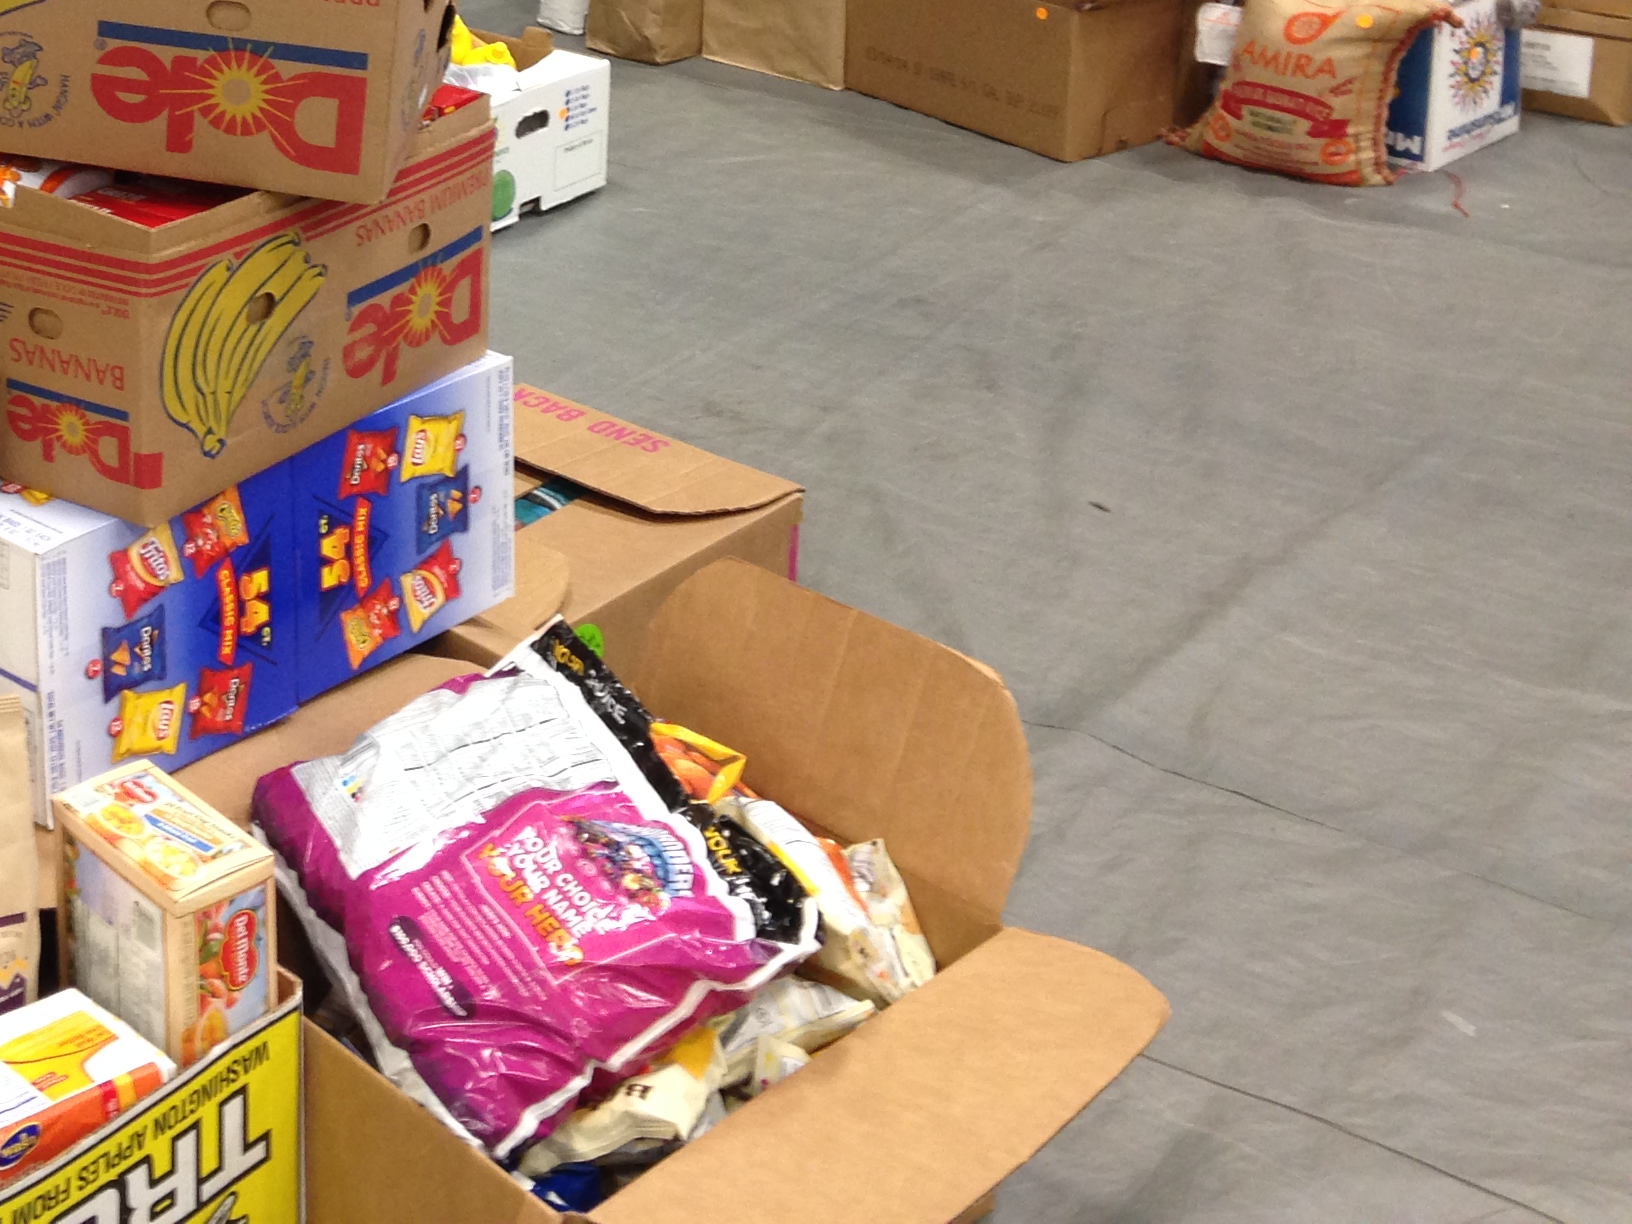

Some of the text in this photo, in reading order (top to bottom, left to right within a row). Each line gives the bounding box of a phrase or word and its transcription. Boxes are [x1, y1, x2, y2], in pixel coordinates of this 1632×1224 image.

[1242, 39, 1337, 79] AMIRA
[89, 44, 369, 176] Dole
[342, 246, 485, 387] Dole
[8, 336, 125, 392] BANANAS
[5, 393, 132, 485] Dole
[587, 419, 672, 453] SEND
[138, 536, 172, 581] Fritos
[319, 525, 352, 593] 54
[353, 505, 370, 589] CLASSIC MIX
[219, 569, 237, 656] CLASSIC MIX
[238, 566, 271, 636] 54
[223, 677, 240, 721] Doritos
[514, 826, 563, 876] YOUR
[476, 843, 535, 905] YOUR
[523, 903, 586, 966] HERO
[505, 841, 594, 939] YOUR NAME
[234, 915, 250, 982] Del Monte
[153, 1040, 271, 1142] WASHINGTON
[77, 1134, 149, 1192] APPLES
[11, 1181, 72, 1224] FROM
